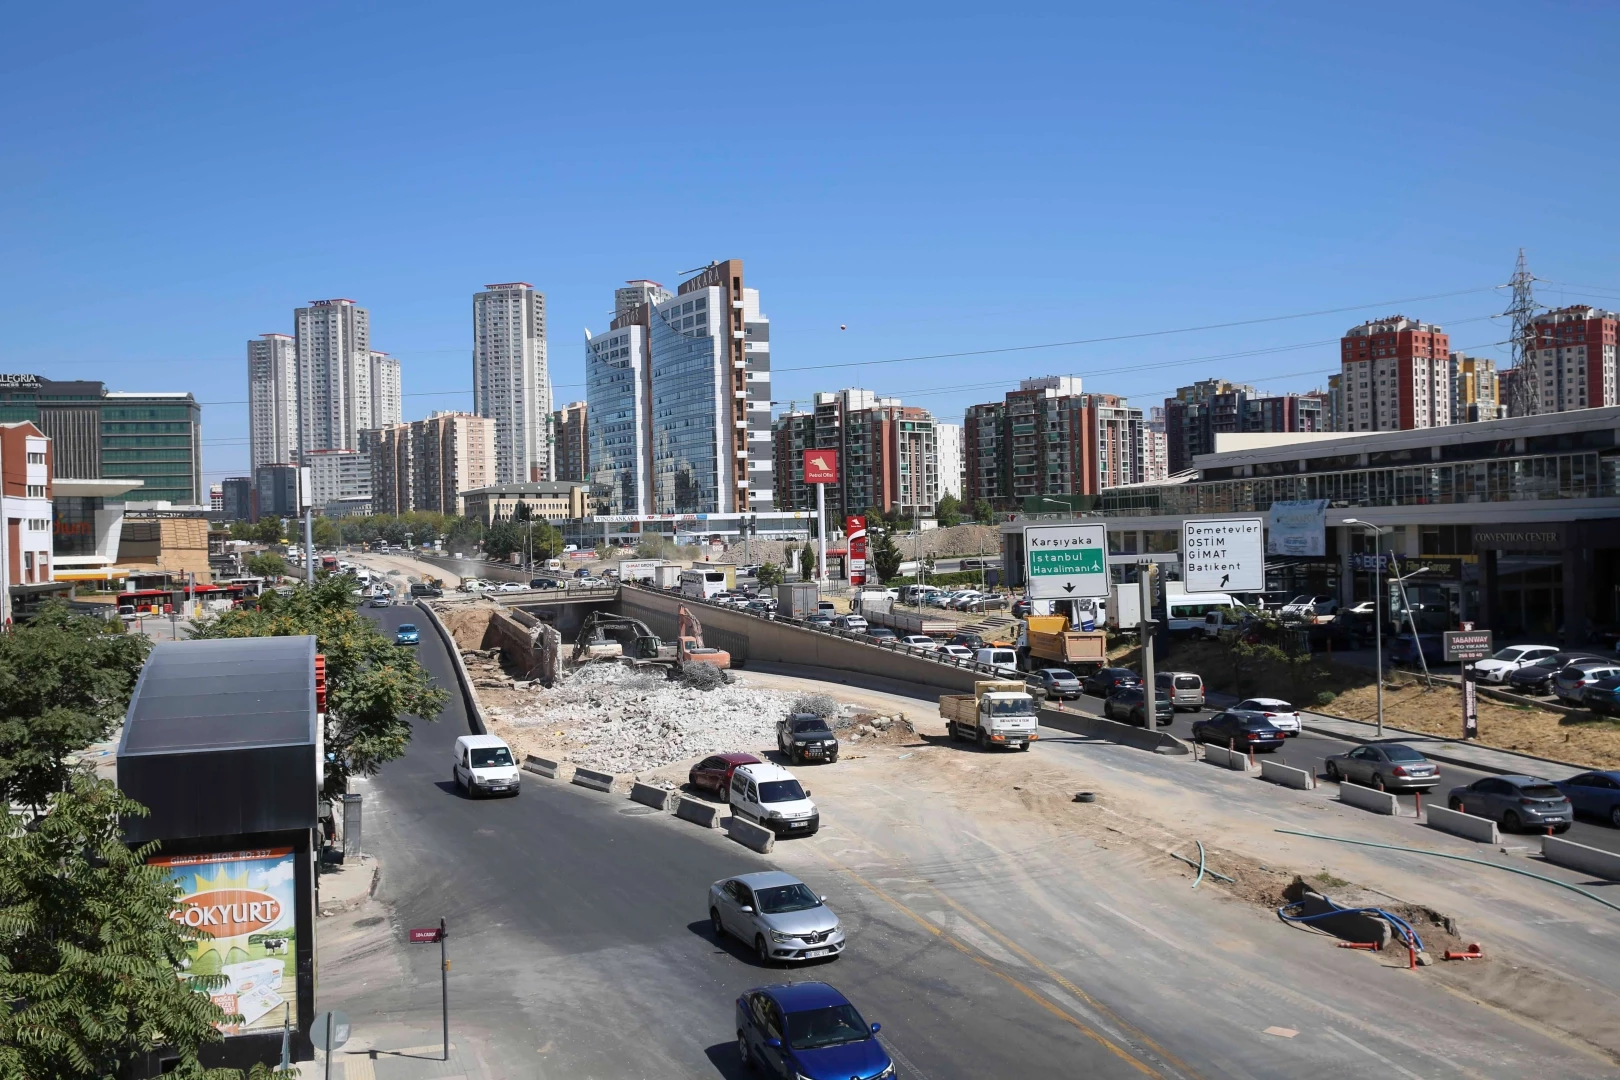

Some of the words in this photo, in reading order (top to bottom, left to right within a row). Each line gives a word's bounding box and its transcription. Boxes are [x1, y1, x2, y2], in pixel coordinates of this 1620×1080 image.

[687, 267, 720, 293] ANKARA
[1188, 524, 1258, 535] Demetevler
[1031, 537, 1092, 548] Karşıyaka
[1188, 535, 1225, 547] OSTİM
[1475, 532, 1524, 542] CONVENTION
[1525, 532, 1557, 542] CENTER
[1032, 551, 1083, 563] İstanbul
[1188, 549, 1227, 559] GİMAT
[1033, 564, 1090, 574] Havalimanı
[1188, 563, 1240, 572] Batıkent
[1452, 636, 1488, 644] TABANWAY
[170, 855, 198, 865] GİMAT
[256, 849, 272, 858] 337
[169, 900, 276, 927] GÖKYURT
